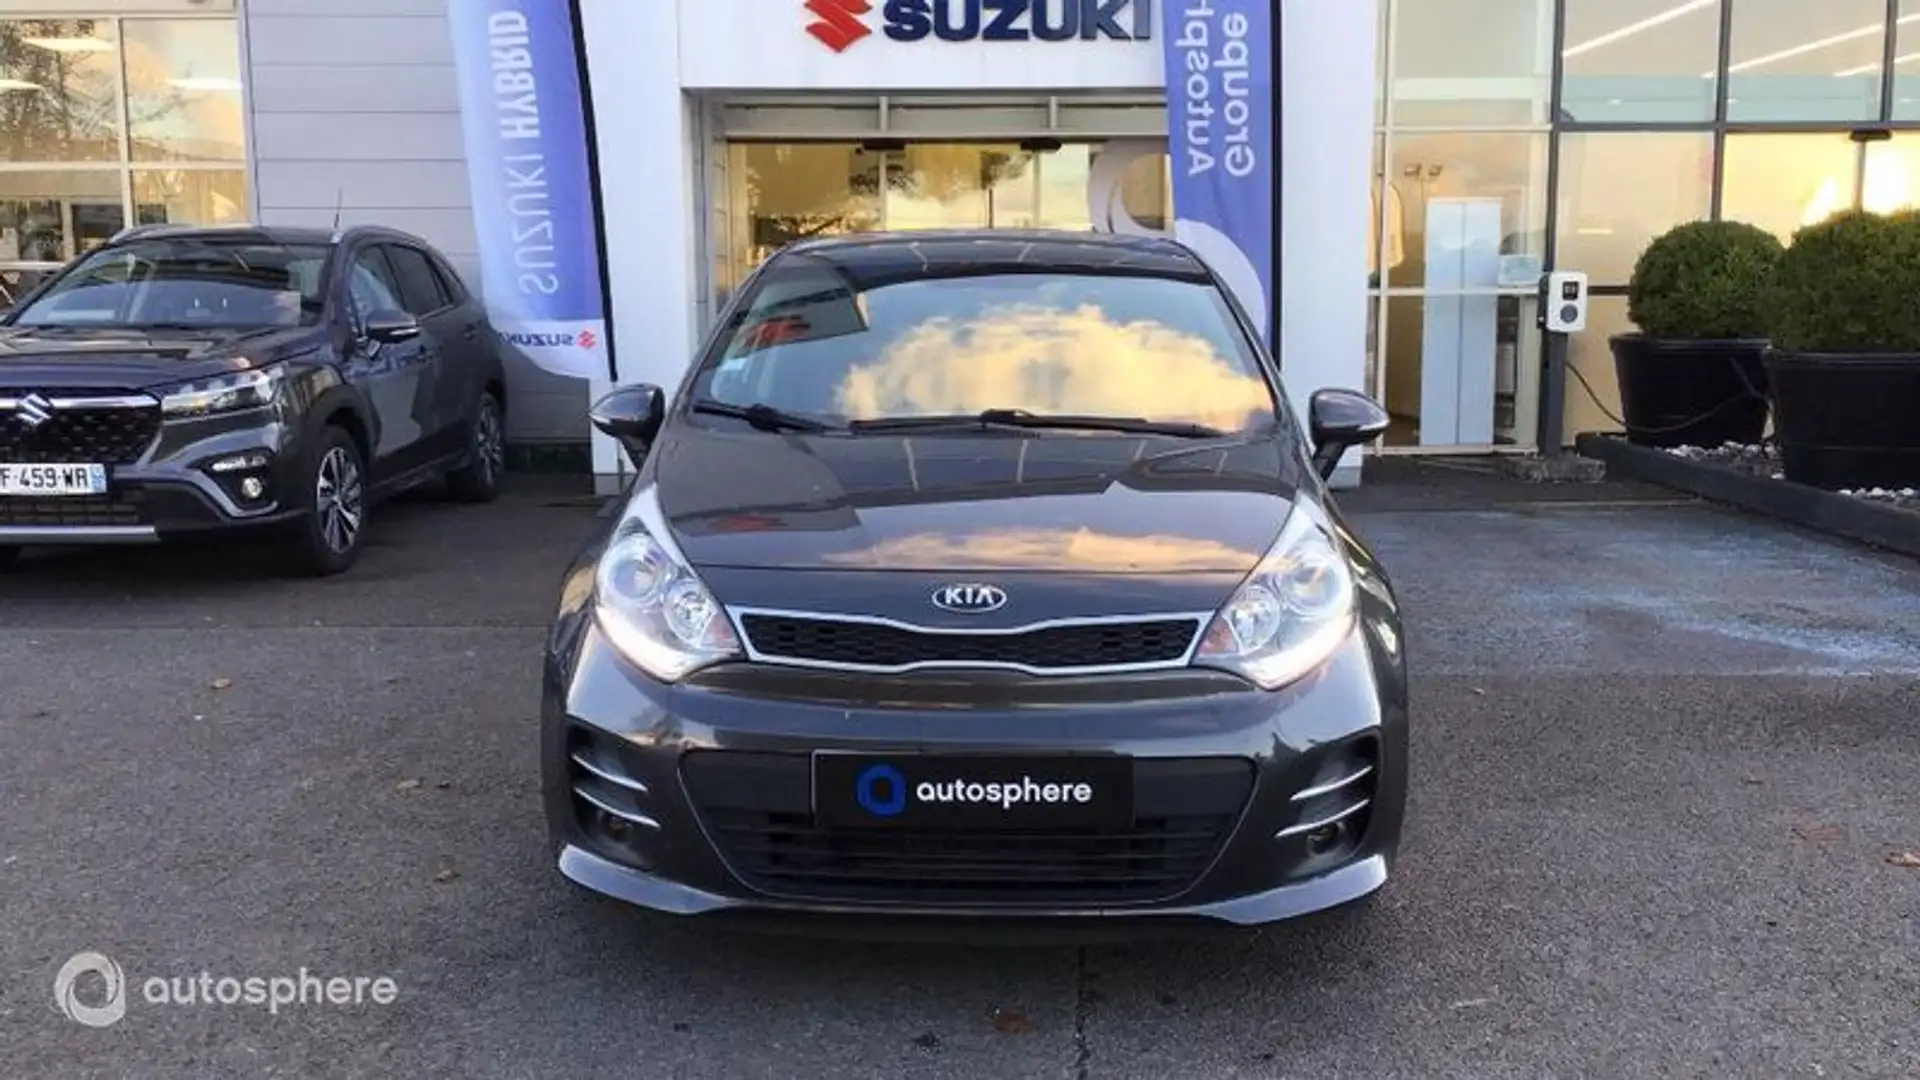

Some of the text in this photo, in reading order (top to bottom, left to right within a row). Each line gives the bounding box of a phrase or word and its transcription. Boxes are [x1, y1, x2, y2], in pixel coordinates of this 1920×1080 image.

[883, 0, 1151, 42] SUZUKI
[945, 587, 994, 604] KIA
[916, 776, 1093, 809] autosphere
